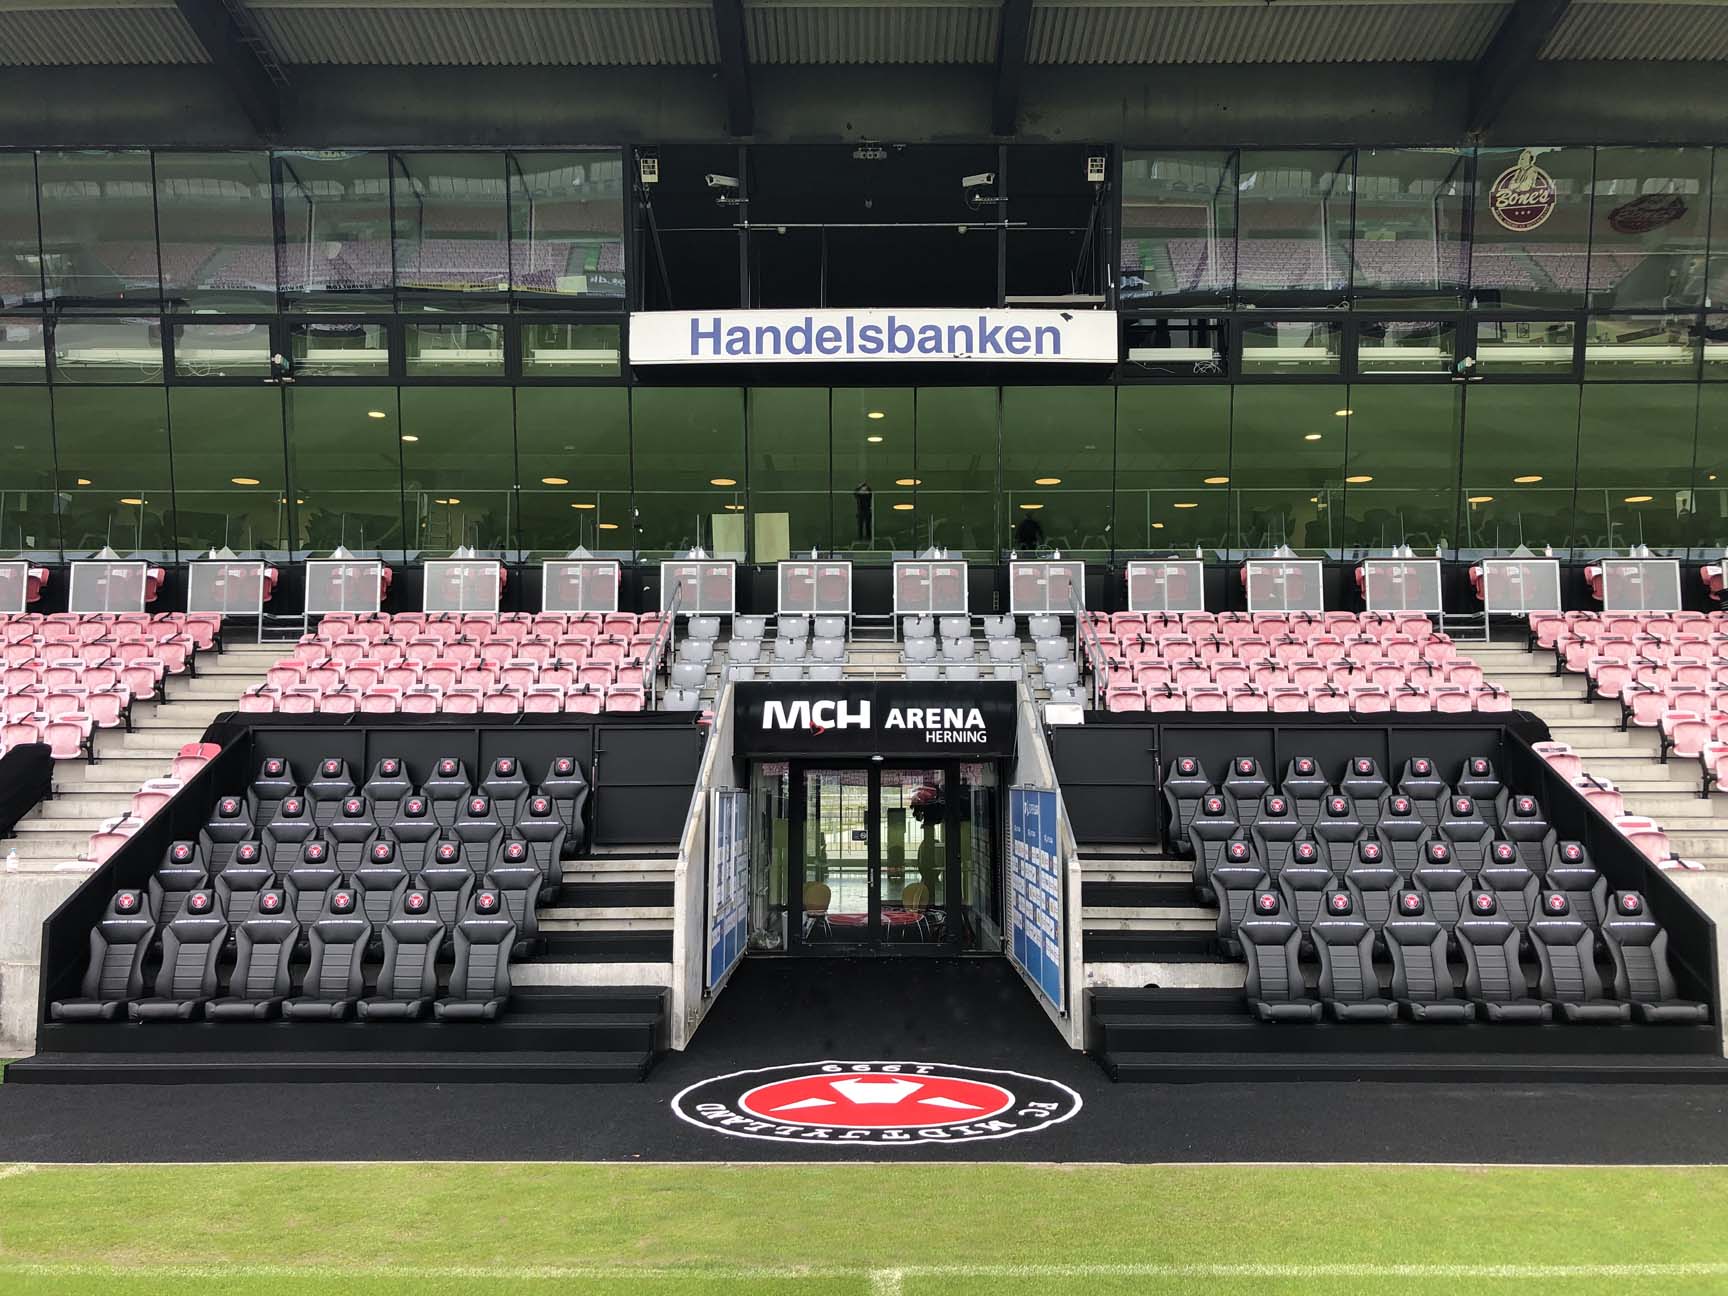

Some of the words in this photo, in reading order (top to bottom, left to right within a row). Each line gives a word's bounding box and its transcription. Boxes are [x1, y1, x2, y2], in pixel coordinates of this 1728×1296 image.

[1496, 188, 1550, 208] Bone's
[690, 315, 1062, 356] Handelsbanken
[762, 699, 871, 730] MCH
[884, 707, 986, 729] ARENA
[925, 730, 987, 743] HERNING
[821, 1064, 934, 1074] 1999
[1017, 1100, 1060, 1118] FC
[694, 1102, 1017, 1142] MIDTJYLLAND
